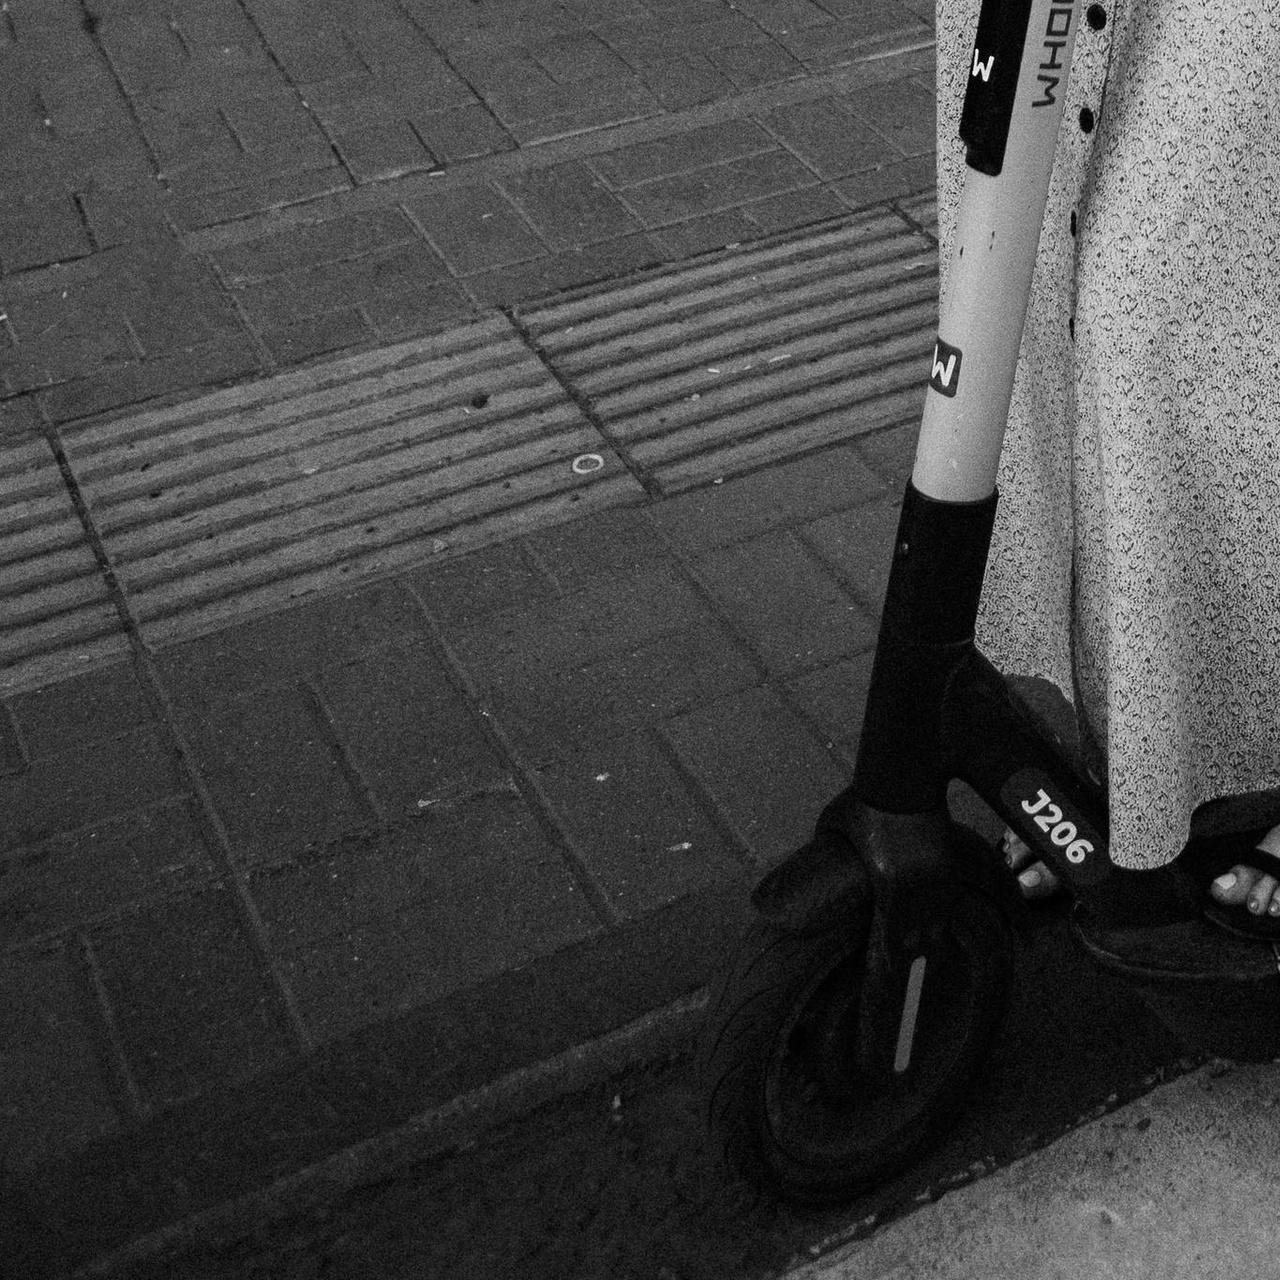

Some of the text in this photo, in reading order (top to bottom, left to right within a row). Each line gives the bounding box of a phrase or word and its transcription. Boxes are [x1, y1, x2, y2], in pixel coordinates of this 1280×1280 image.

[972, 48, 995, 82] W
[931, 343, 957, 387] W
[1021, 788, 1095, 864] J206
